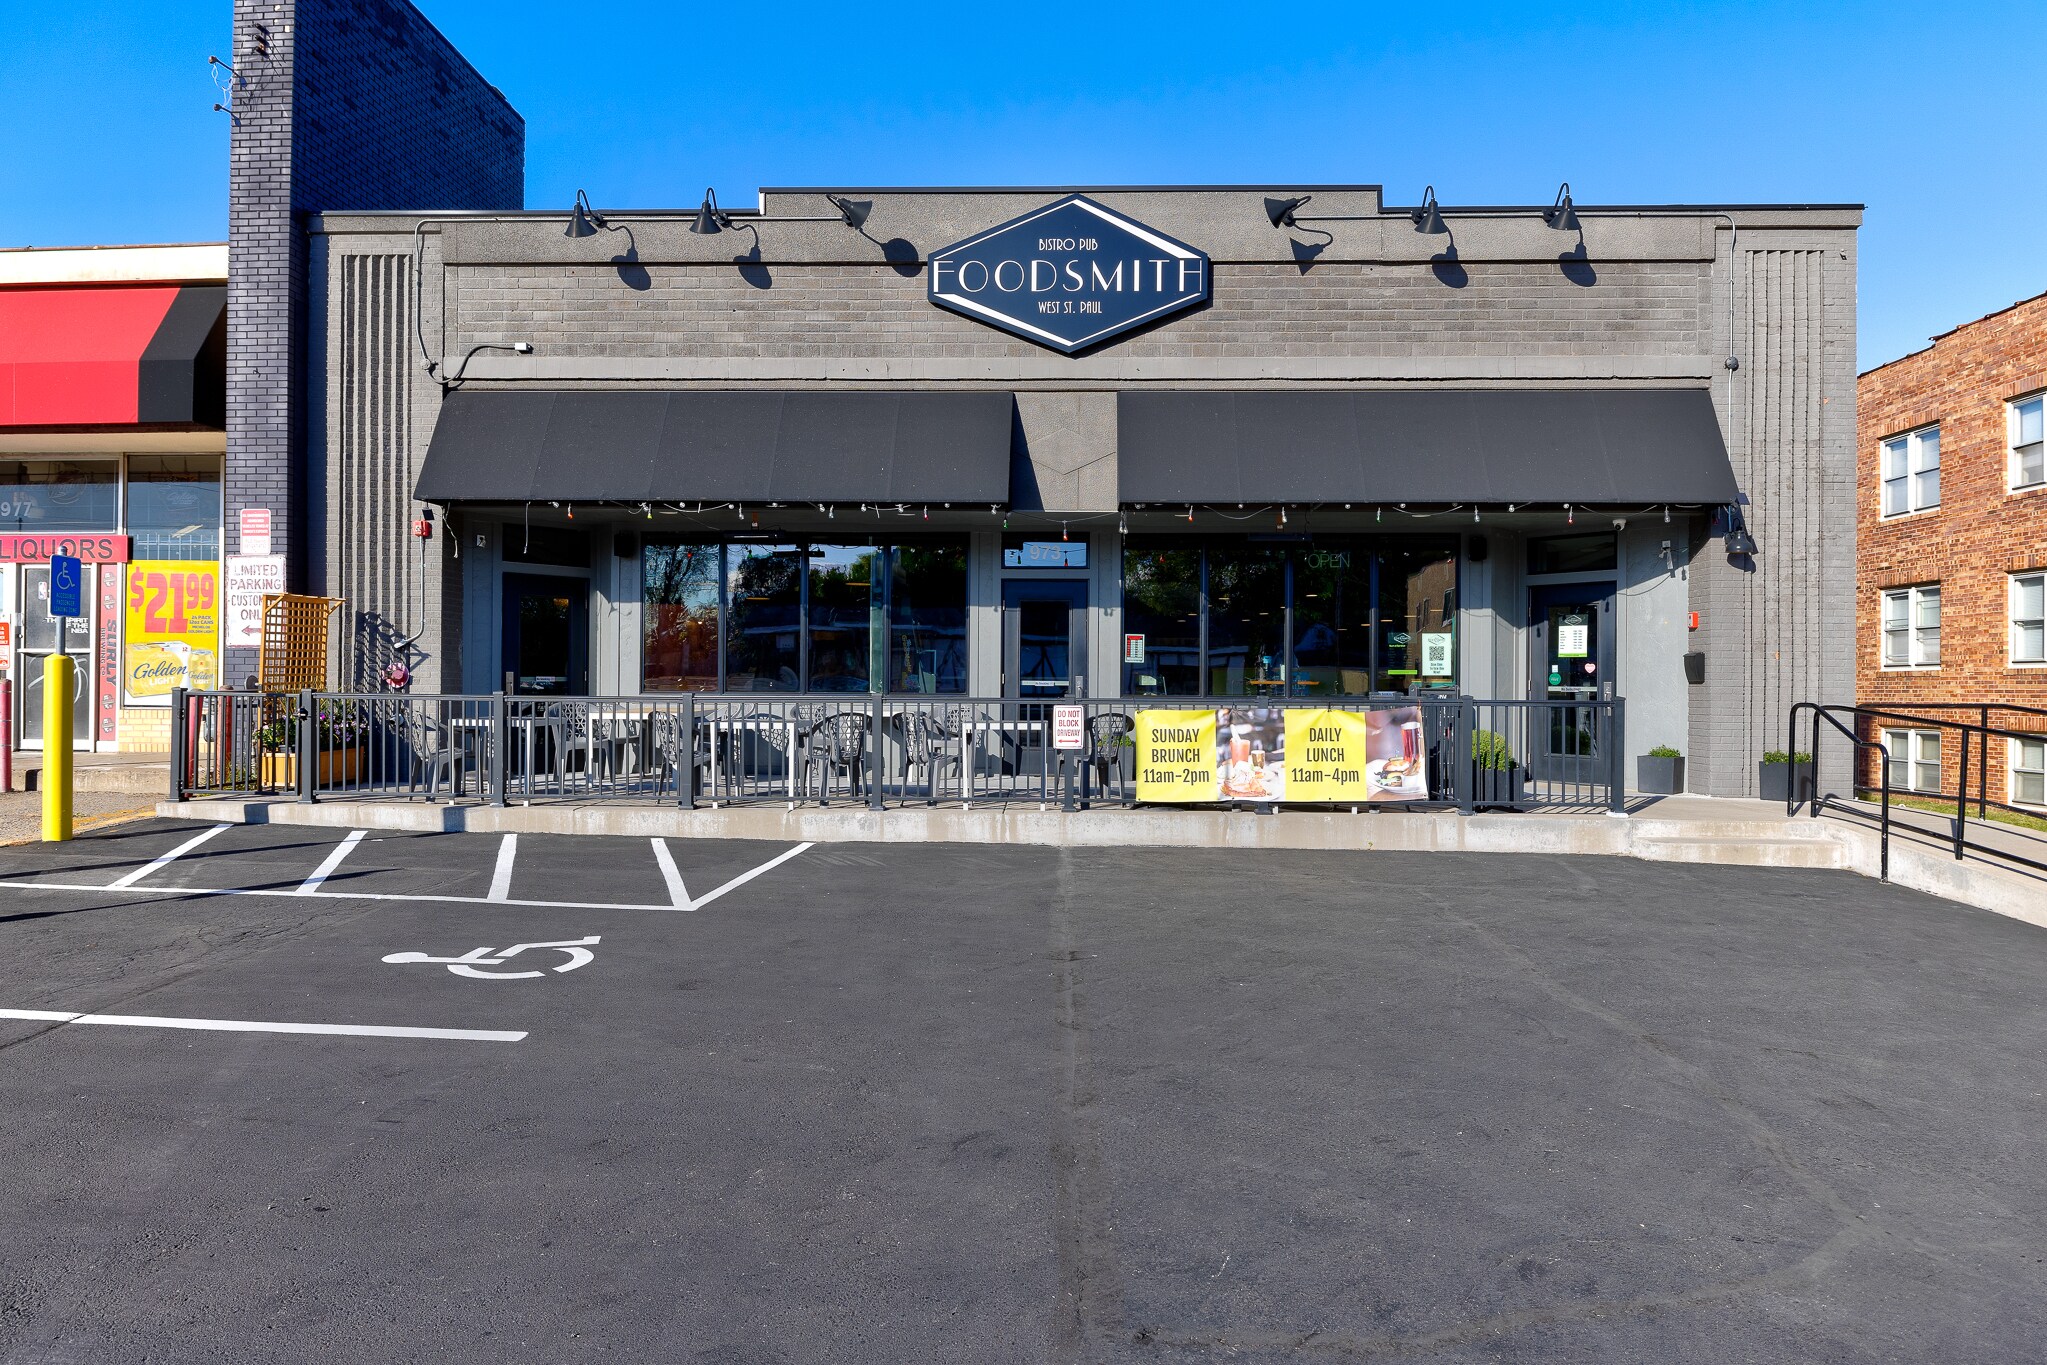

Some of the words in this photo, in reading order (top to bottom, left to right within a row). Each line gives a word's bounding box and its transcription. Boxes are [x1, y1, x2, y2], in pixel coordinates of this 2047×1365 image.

[1039, 238, 1076, 251] BISTRO
[1079, 238, 1098, 251] PUB
[933, 259, 1202, 293] FOODSMITH
[1038, 301, 1060, 314] WEST
[1063, 301, 1076, 314] ST.
[1079, 301, 1102, 314] PAUL
[0, 501, 32, 517] 977
[0, 538, 113, 561] LIQUORS
[1030, 544, 1061, 560] 973
[1308, 553, 1350, 568] OPEN
[234, 564, 278, 576] LIMITED
[230, 578, 282, 590] PARKING
[240, 609, 263, 620] ONL
[106, 618, 116, 687] SURLY
[133, 660, 188, 679] Golden
[188, 671, 213, 680] Golden
[150, 677, 176, 686] LIGHT
[1058, 719, 1079, 727] BLOCK
[1151, 728, 1200, 743] SUNDAY
[1309, 727, 1342, 743] DAILY
[1151, 748, 1200, 763] BRUNCH
[1306, 747, 1345, 763] LUNCH
[1143, 767, 1210, 786] 11am-2pm
[1291, 767, 1360, 786] 11am-4pm
